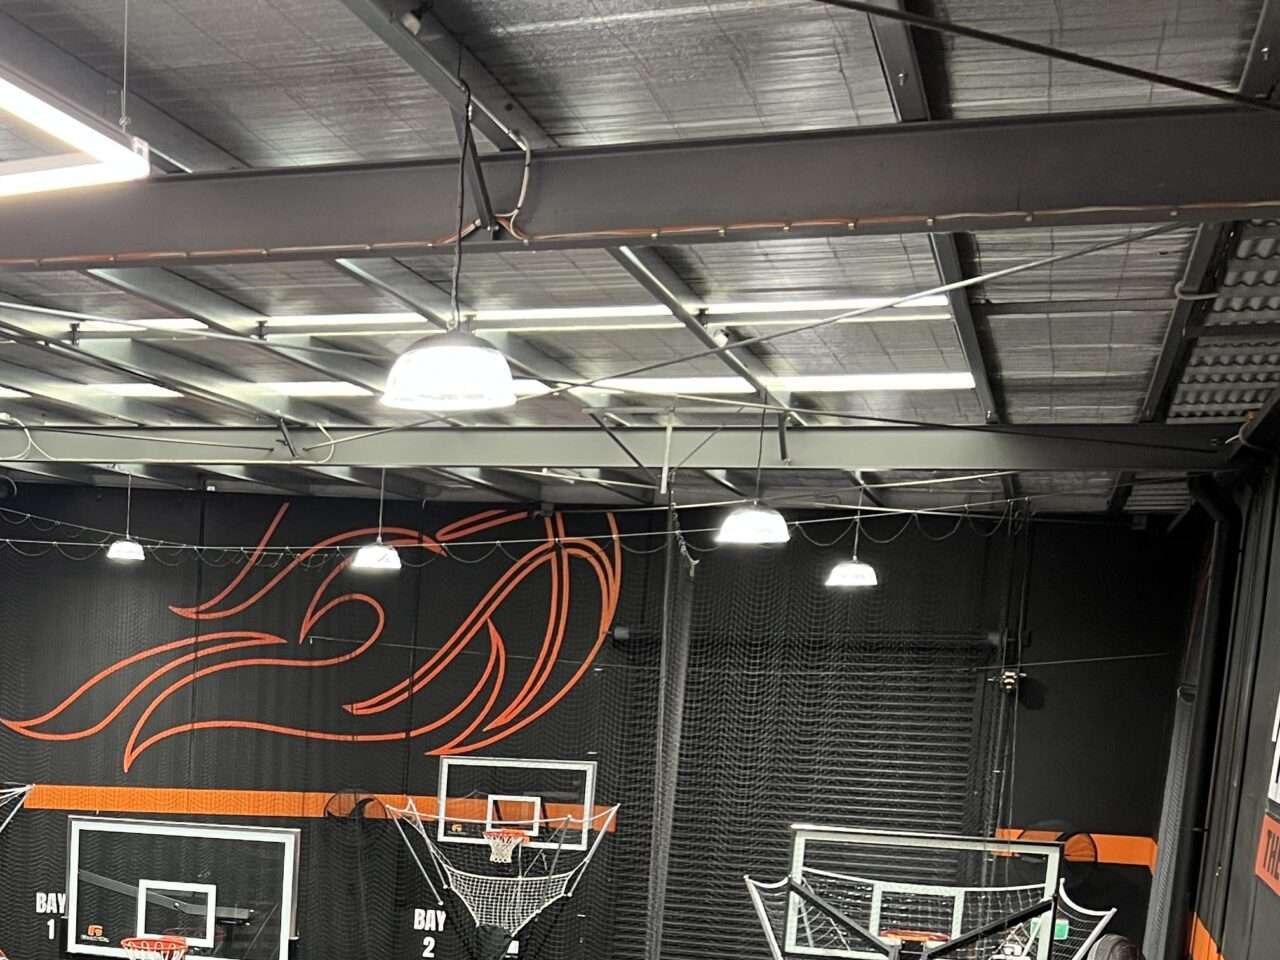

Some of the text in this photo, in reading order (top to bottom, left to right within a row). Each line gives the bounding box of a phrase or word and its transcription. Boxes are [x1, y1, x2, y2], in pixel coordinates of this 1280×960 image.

[35, 892, 66, 914] BAY
[47, 918, 56, 940] 1
[413, 908, 447, 932] BAY
[422, 936, 436, 958] 2
